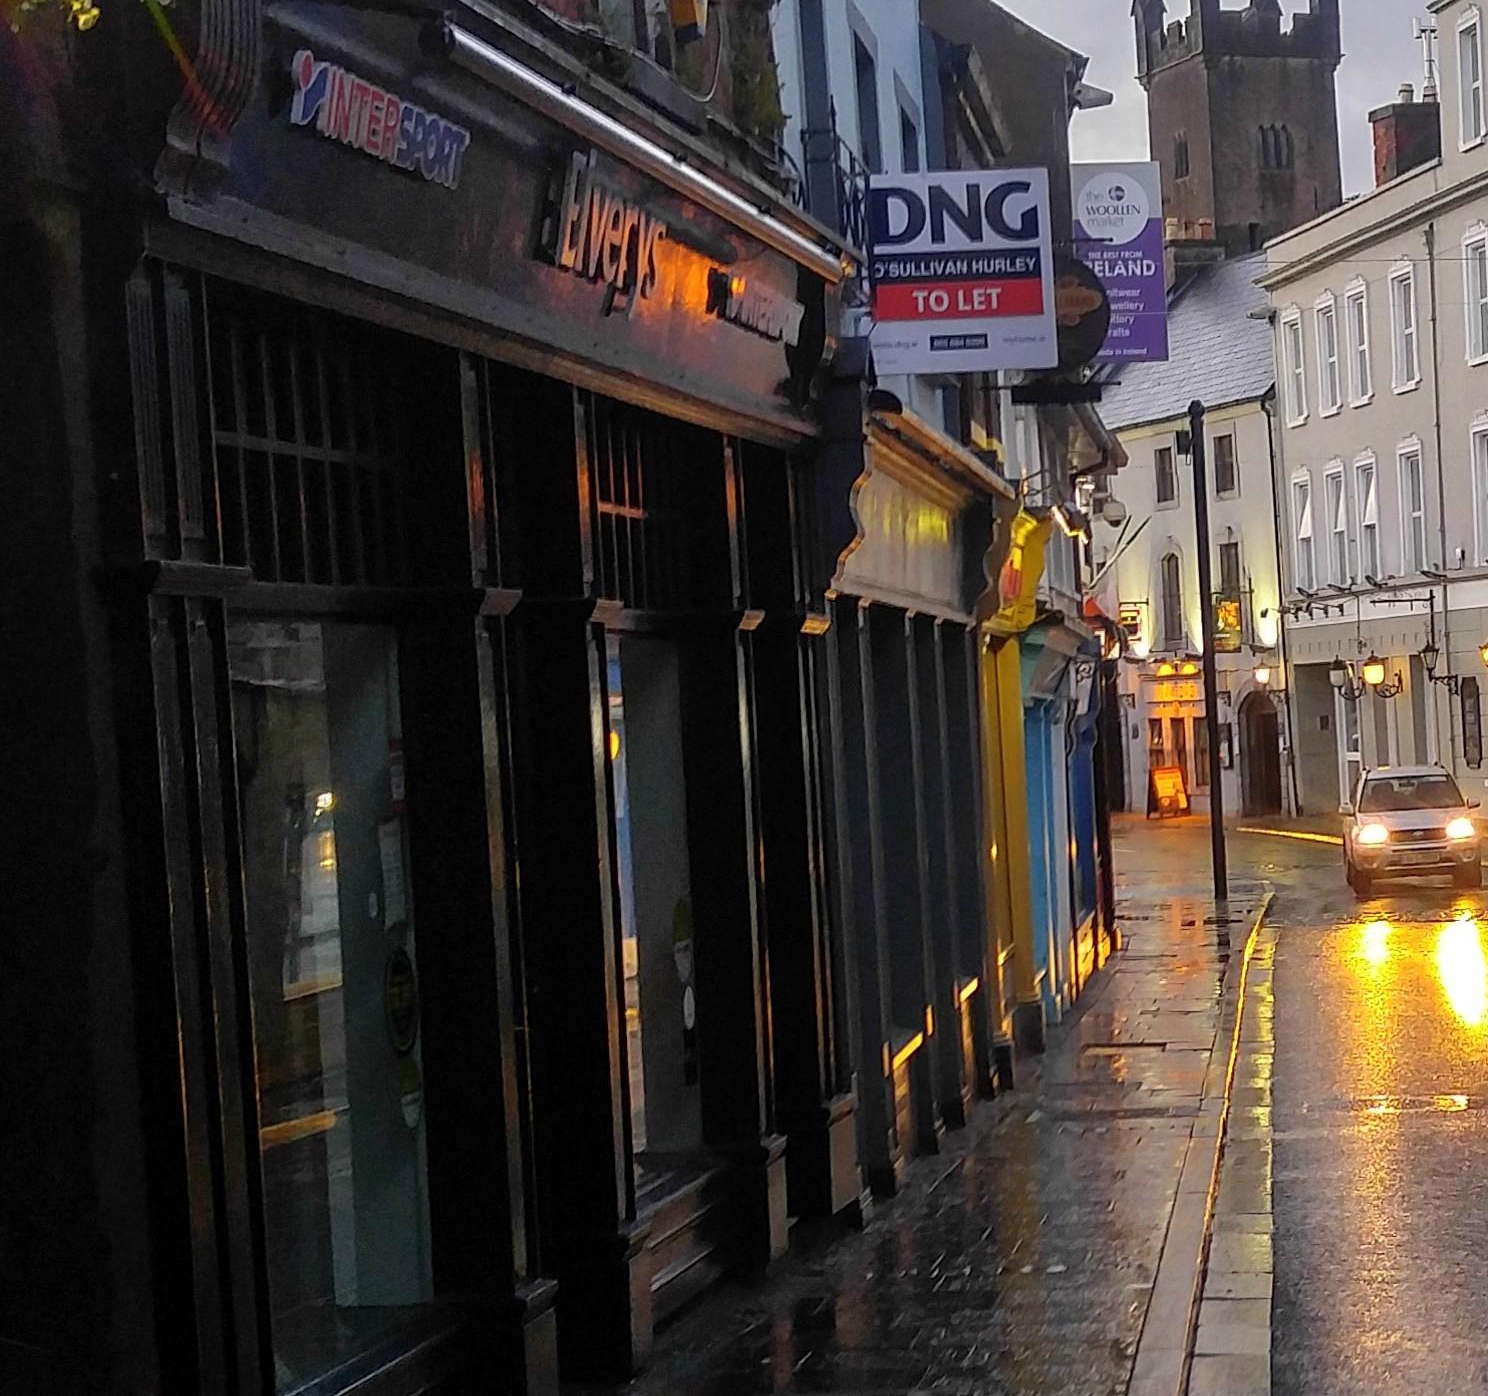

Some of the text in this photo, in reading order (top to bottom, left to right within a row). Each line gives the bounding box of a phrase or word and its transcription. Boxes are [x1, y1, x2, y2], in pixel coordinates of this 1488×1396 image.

[320, 59, 473, 190] INTERSPORT
[869, 180, 1041, 246] DNG
[1085, 205, 1141, 216] WOOLLEN
[556, 150, 668, 320] Elverys
[873, 255, 1037, 280] O'SULLIVAN HURLEY
[1120, 250, 1144, 259] FROM
[1083, 259, 1156, 277] ELAND
[911, 286, 1002, 314] TO LET
